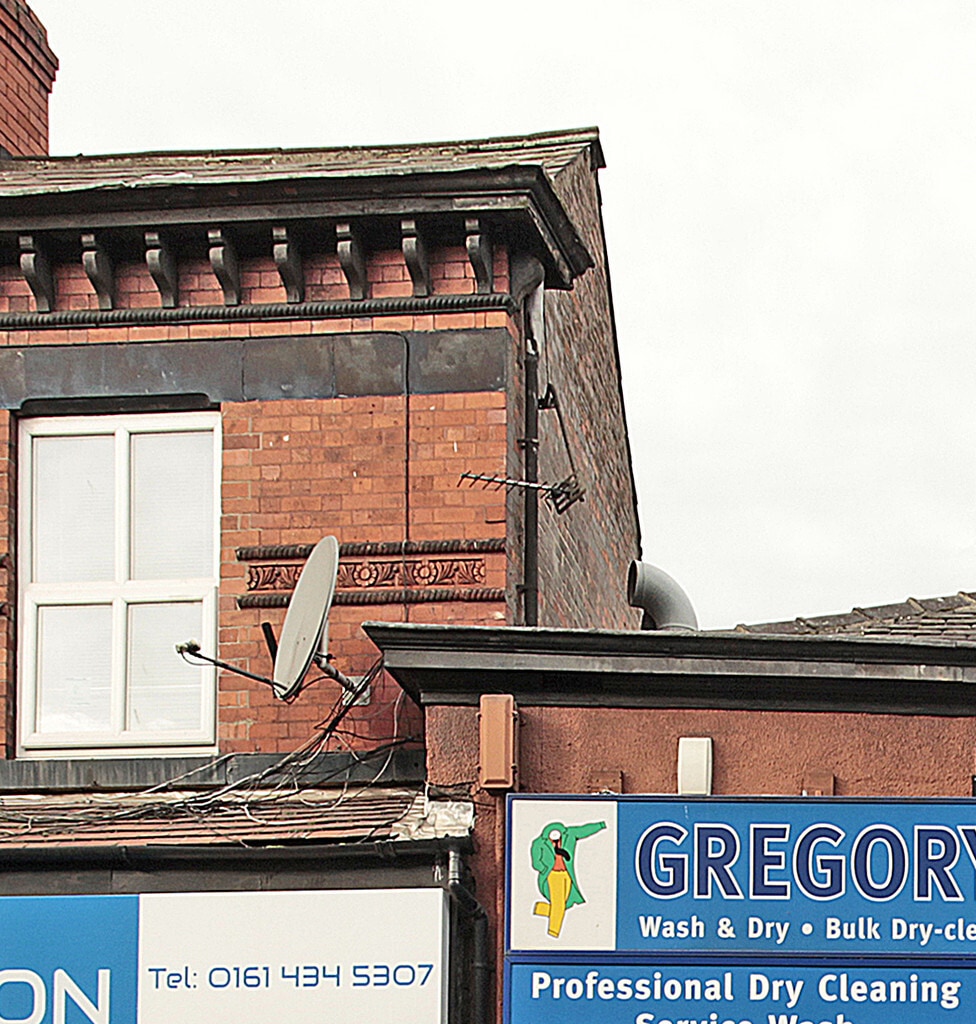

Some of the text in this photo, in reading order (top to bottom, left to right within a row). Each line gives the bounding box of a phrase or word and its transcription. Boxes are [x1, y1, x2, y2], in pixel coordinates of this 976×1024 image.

[639, 916, 790, 944] Wash & Dry
[826, 917, 881, 941] Bulk
[148, 964, 434, 990] Tel: 0161 434 5307
[532, 972, 962, 1009] Professional Dry Cleaning
